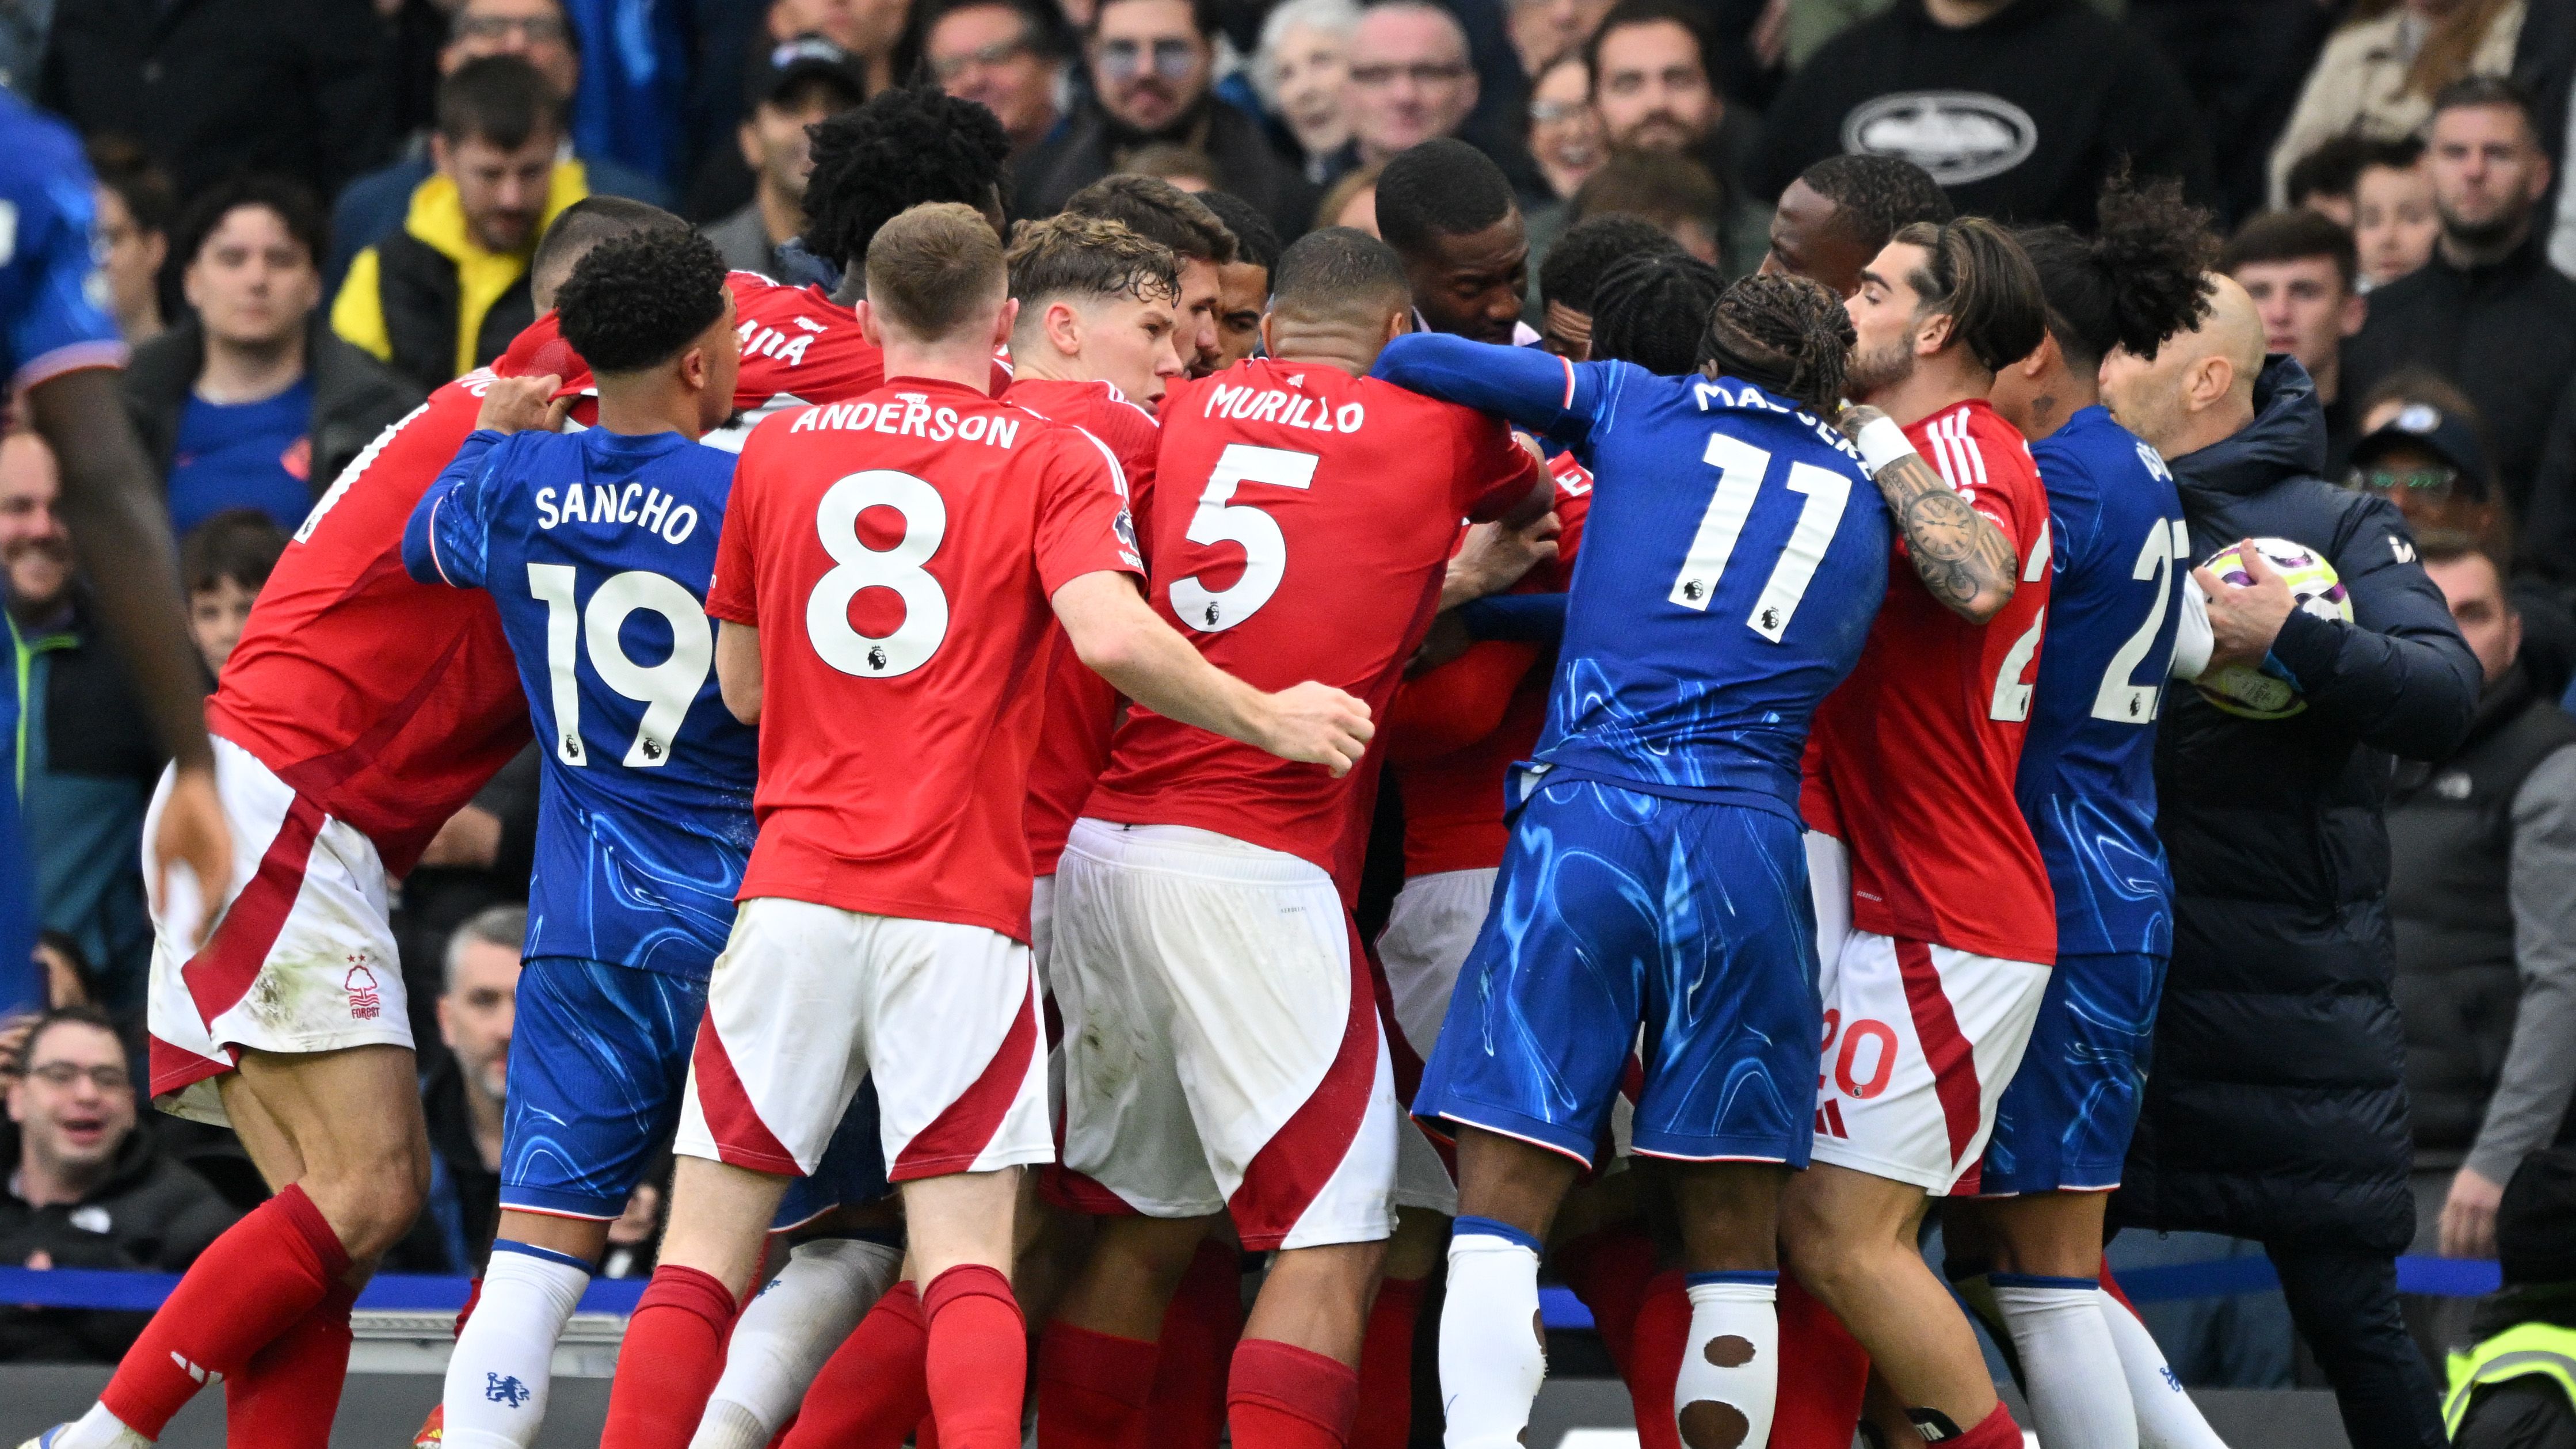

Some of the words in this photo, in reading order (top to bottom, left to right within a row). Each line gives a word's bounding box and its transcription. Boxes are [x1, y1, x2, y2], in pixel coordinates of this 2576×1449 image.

[790, 403, 1020, 449] ANDERSON
[1204, 383, 1365, 433] MURILLO
[536, 483, 698, 544] SANCHO
[805, 468, 950, 679] 8
[1169, 443, 1320, 634] 5
[1668, 433, 1853, 644] 11
[527, 563, 713, 767] 19
